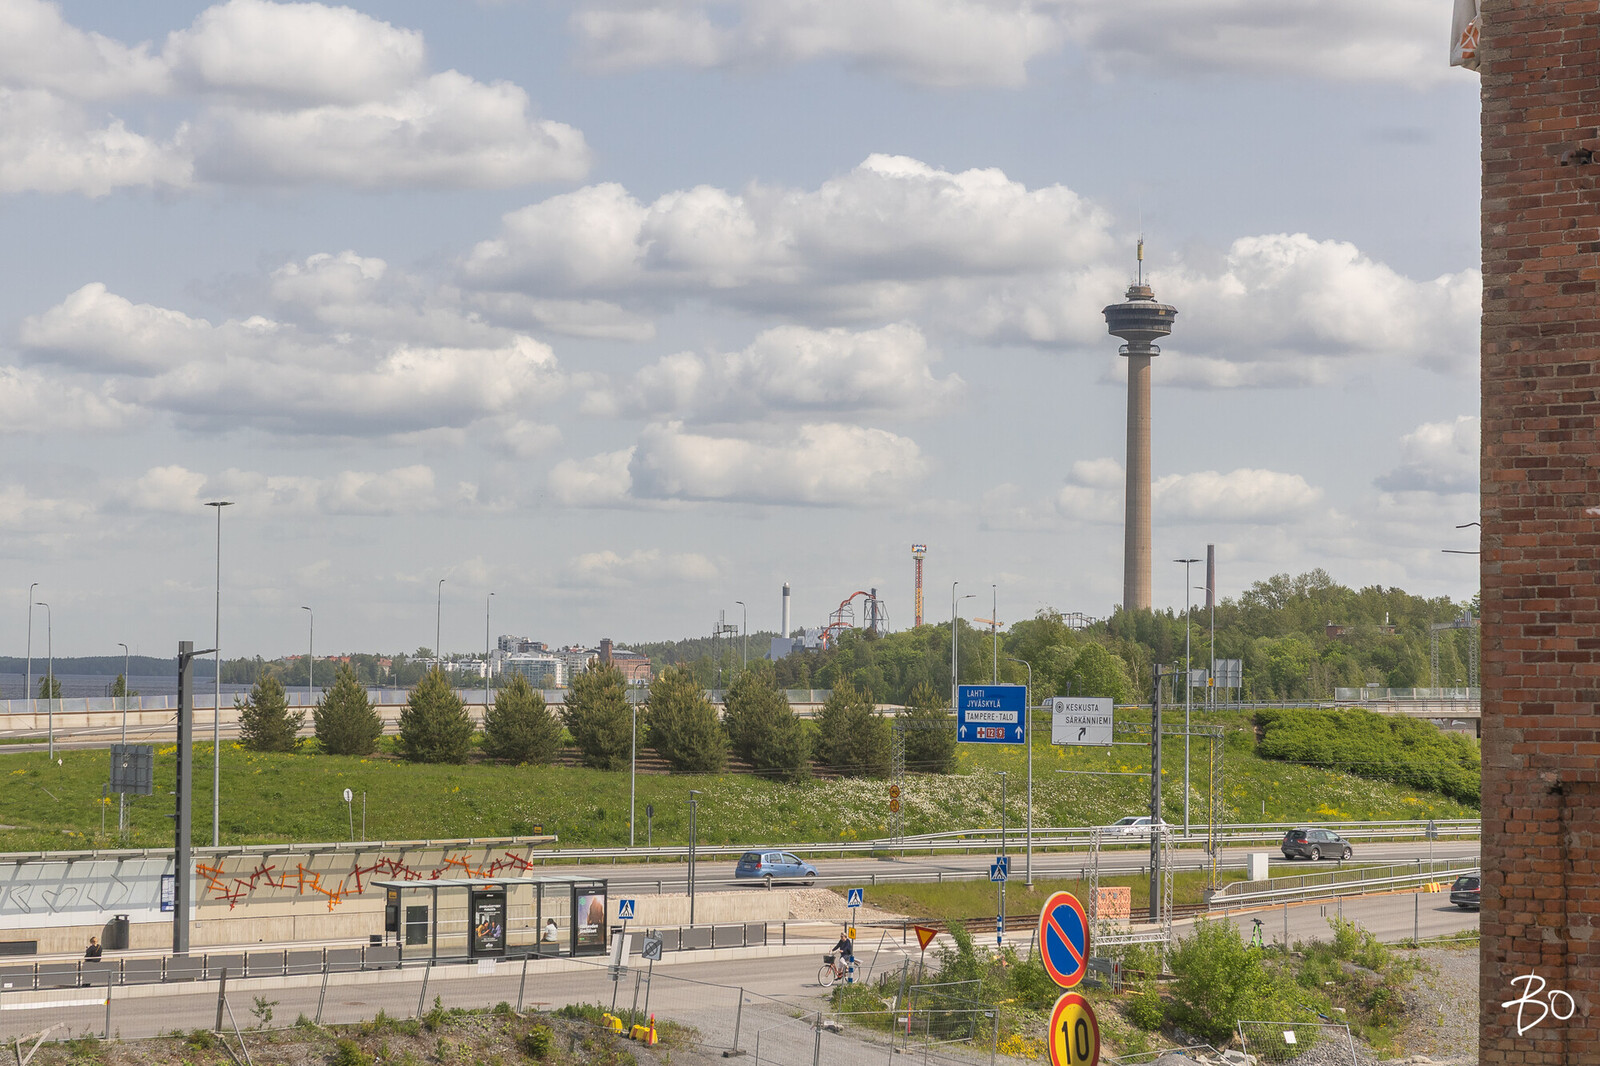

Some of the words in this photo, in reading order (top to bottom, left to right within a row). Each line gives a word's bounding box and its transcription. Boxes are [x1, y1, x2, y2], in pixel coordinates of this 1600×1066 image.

[966, 689, 985, 698] LAHTI
[966, 699, 1001, 708] JYVÄSKYLÄ
[1065, 703, 1099, 711] KESKUSTA
[987, 729, 994, 737] 12
[998, 729, 1003, 737] 9
[1061, 1017, 1089, 1065] 10
